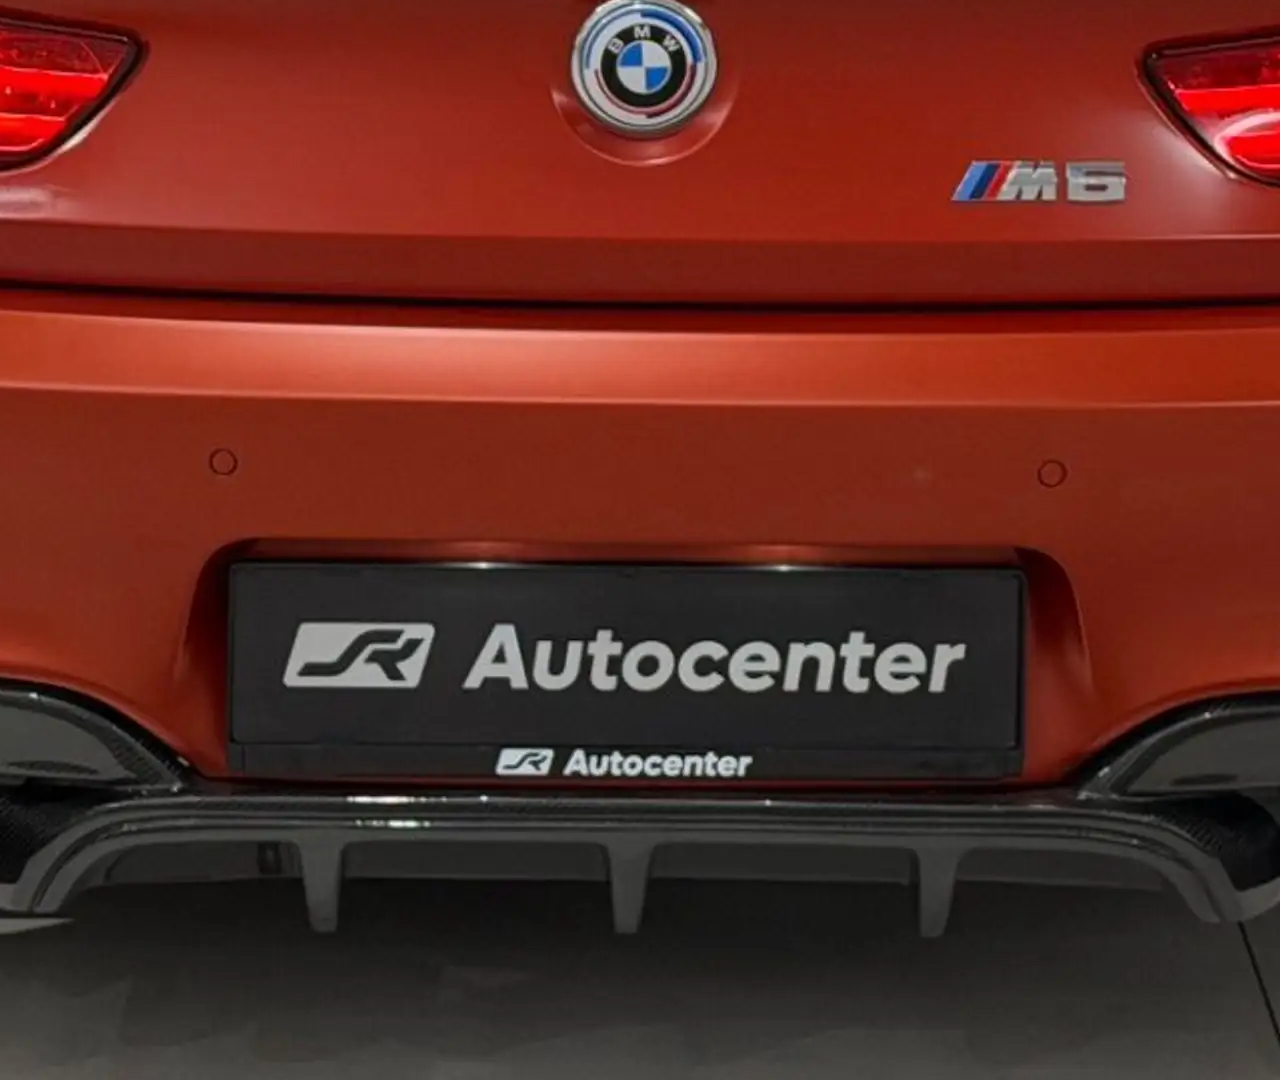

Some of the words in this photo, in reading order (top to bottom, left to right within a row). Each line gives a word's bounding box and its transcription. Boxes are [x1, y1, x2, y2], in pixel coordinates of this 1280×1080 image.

[607, 25, 680, 54] BMW
[996, 160, 1127, 202] M6
[463, 624, 966, 693] Autocenter
[563, 748, 753, 777] Autocenter
